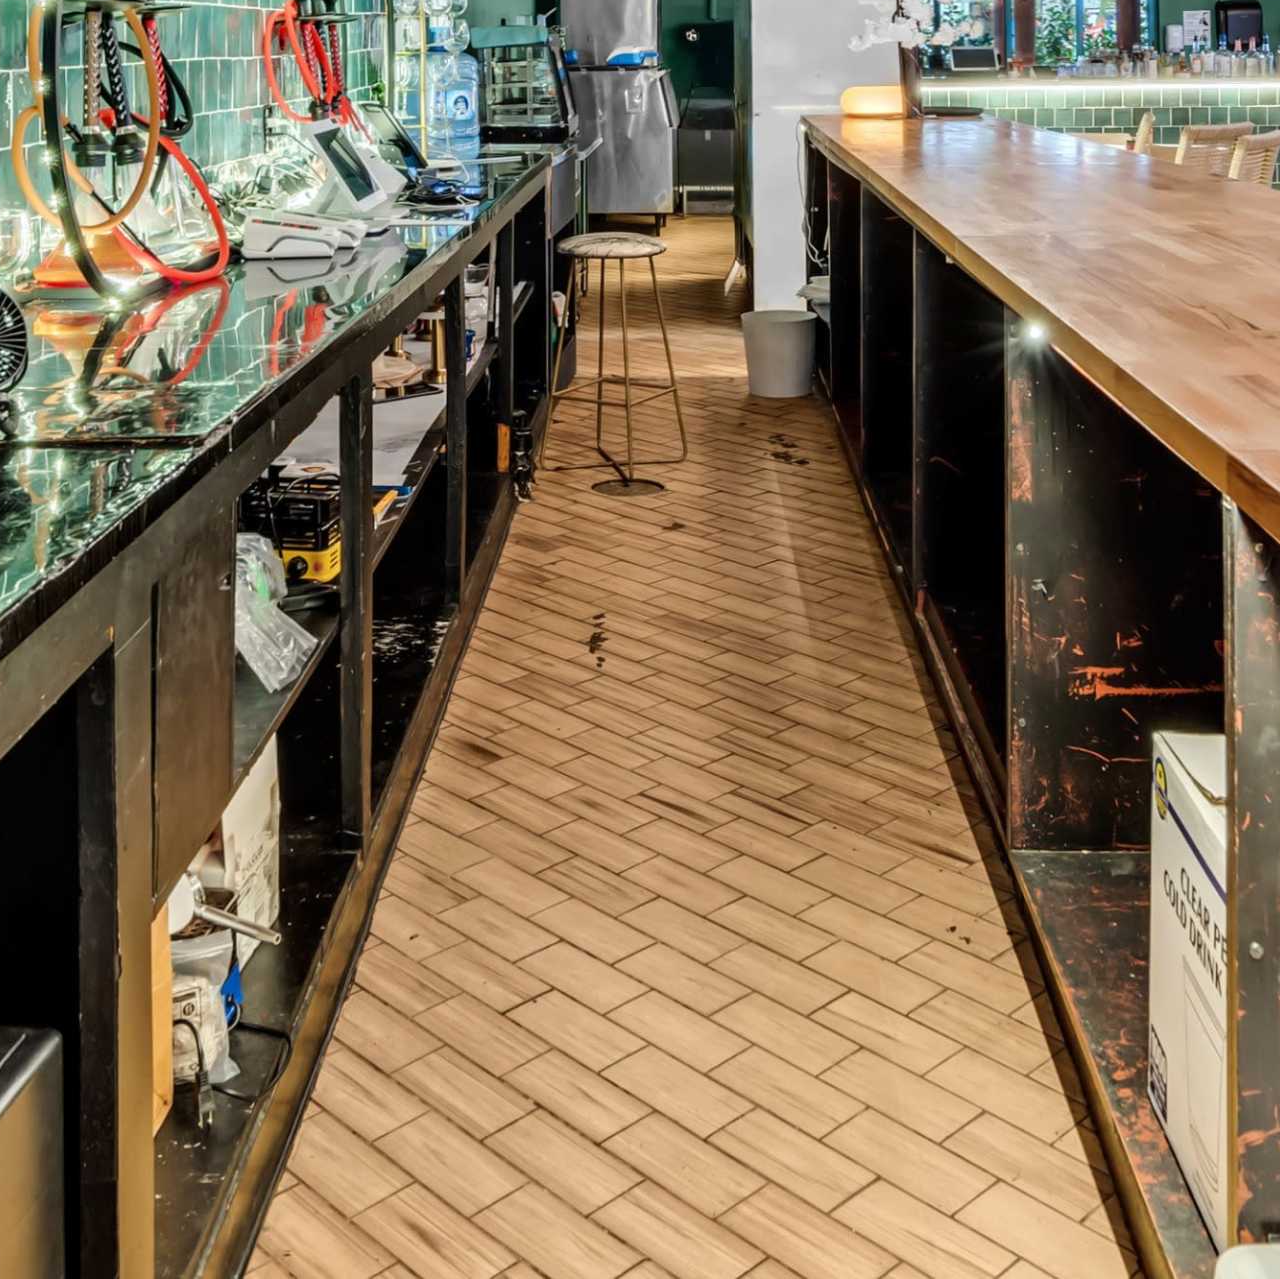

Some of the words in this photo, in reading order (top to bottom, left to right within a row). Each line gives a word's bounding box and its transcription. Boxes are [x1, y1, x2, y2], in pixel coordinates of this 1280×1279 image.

[1163, 869, 1187, 929] COLD
[1189, 917, 1223, 996] DRINK
[1180, 867, 1210, 938] CLEAR
